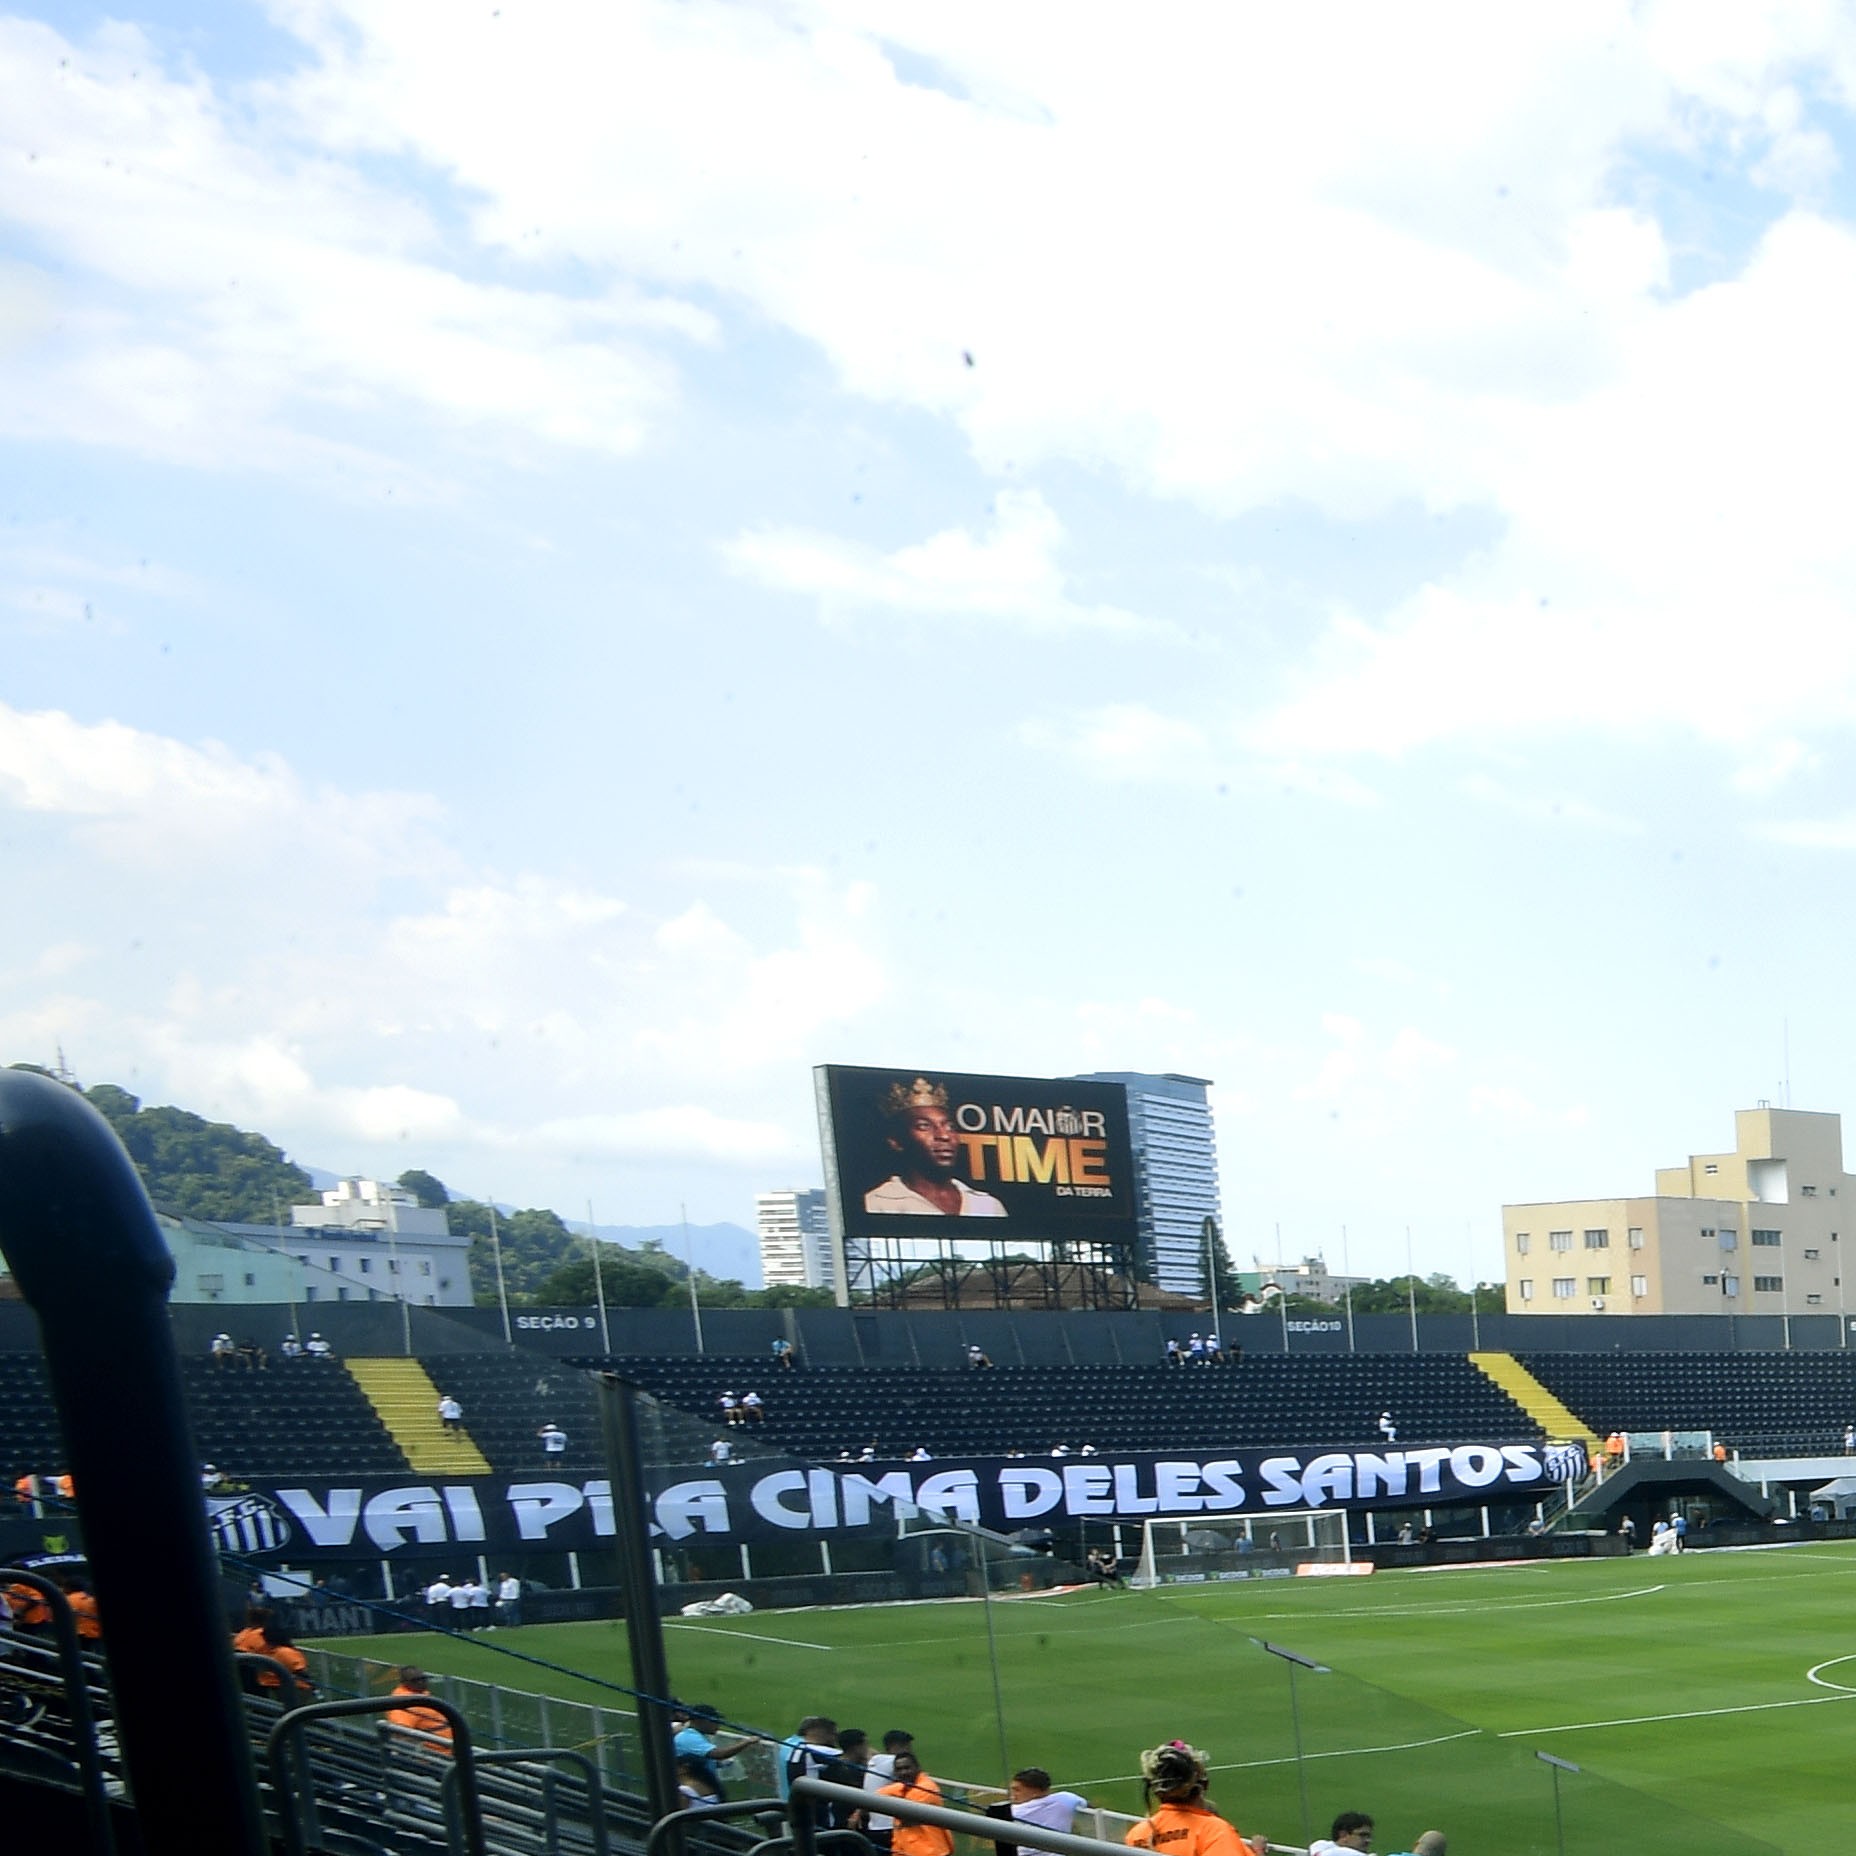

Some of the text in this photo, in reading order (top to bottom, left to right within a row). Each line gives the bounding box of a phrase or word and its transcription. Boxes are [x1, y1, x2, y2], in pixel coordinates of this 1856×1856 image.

[957, 1104, 987, 1131] O
[958, 1132, 1111, 1186] TIME
[1056, 1185, 1113, 1198] DA TERRA
[516, 1313, 596, 1332] SEÇÃO 9
[276, 1485, 487, 1552] VAI
[750, 1469, 980, 1529] CIMA
[998, 1459, 1245, 1520] DELES
[1260, 1445, 1546, 1509] SANTOS
